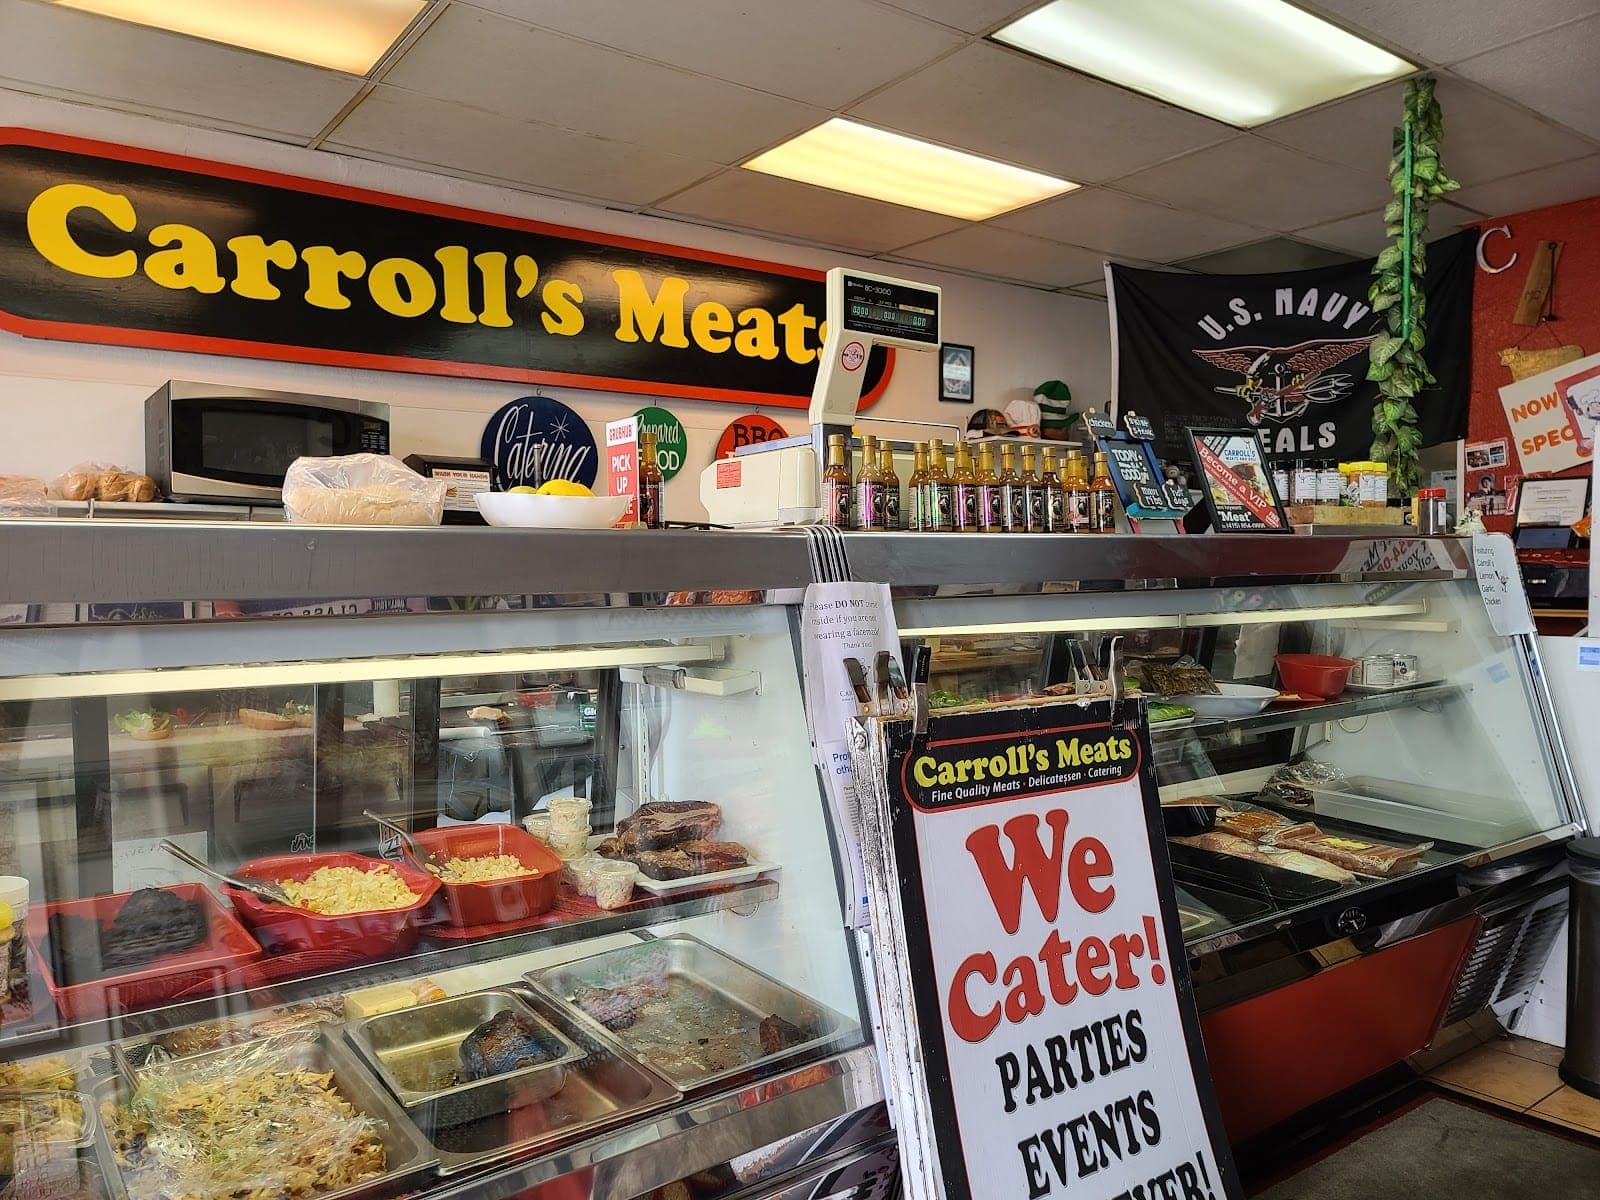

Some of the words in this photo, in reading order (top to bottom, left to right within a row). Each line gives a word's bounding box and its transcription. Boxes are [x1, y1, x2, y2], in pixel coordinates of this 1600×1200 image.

[27, 184, 585, 336] Carroll's
[1197, 298, 1262, 341] U.S.
[1275, 288, 1369, 330] NAVY
[1511, 391, 1558, 422] NOW
[494, 404, 591, 490] Catering
[609, 423, 633, 441] GRUBHUB
[1258, 422, 1337, 453] EALS
[611, 453, 632, 472] PICK
[638, 449, 680, 471] FOD
[1199, 448, 1238, 486] Become
[1248, 489, 1267, 509] VIP
[616, 477, 628, 494] UP
[835, 600, 848, 609] DO
[849, 599, 864, 608] NOT
[842, 615, 857, 625] you
[913, 746, 1050, 789] Carroll's
[1057, 736, 1133, 770] Meats
[931, 789, 953, 803] Fine
[955, 781, 991, 800] Quality
[992, 781, 1021, 794] Meats
[1028, 770, 1082, 789] Delicatessen
[1088, 764, 1123, 779] Catering
[965, 808, 1116, 936] We
[948, 915, 1166, 1044] Cater!
[995, 1009, 1148, 1114] PARTIES
[1018, 1089, 1162, 1200] EVENTS
